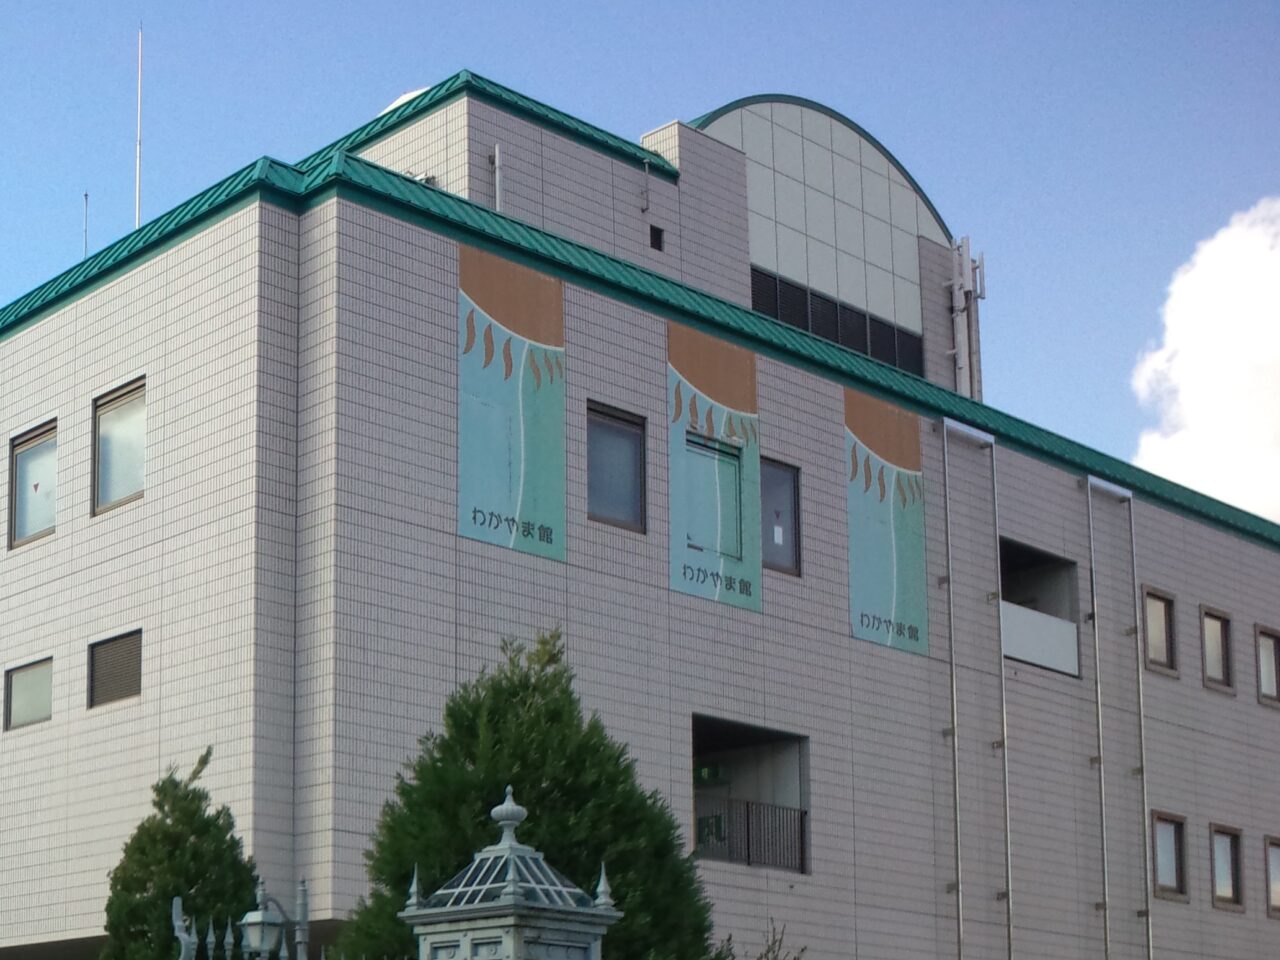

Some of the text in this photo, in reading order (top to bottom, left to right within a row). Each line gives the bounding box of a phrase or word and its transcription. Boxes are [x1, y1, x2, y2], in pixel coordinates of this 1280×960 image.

[472, 507, 554, 546] わかやま館
[682, 563, 753, 598] わかやま館
[859, 611, 920, 642] わかやま館
